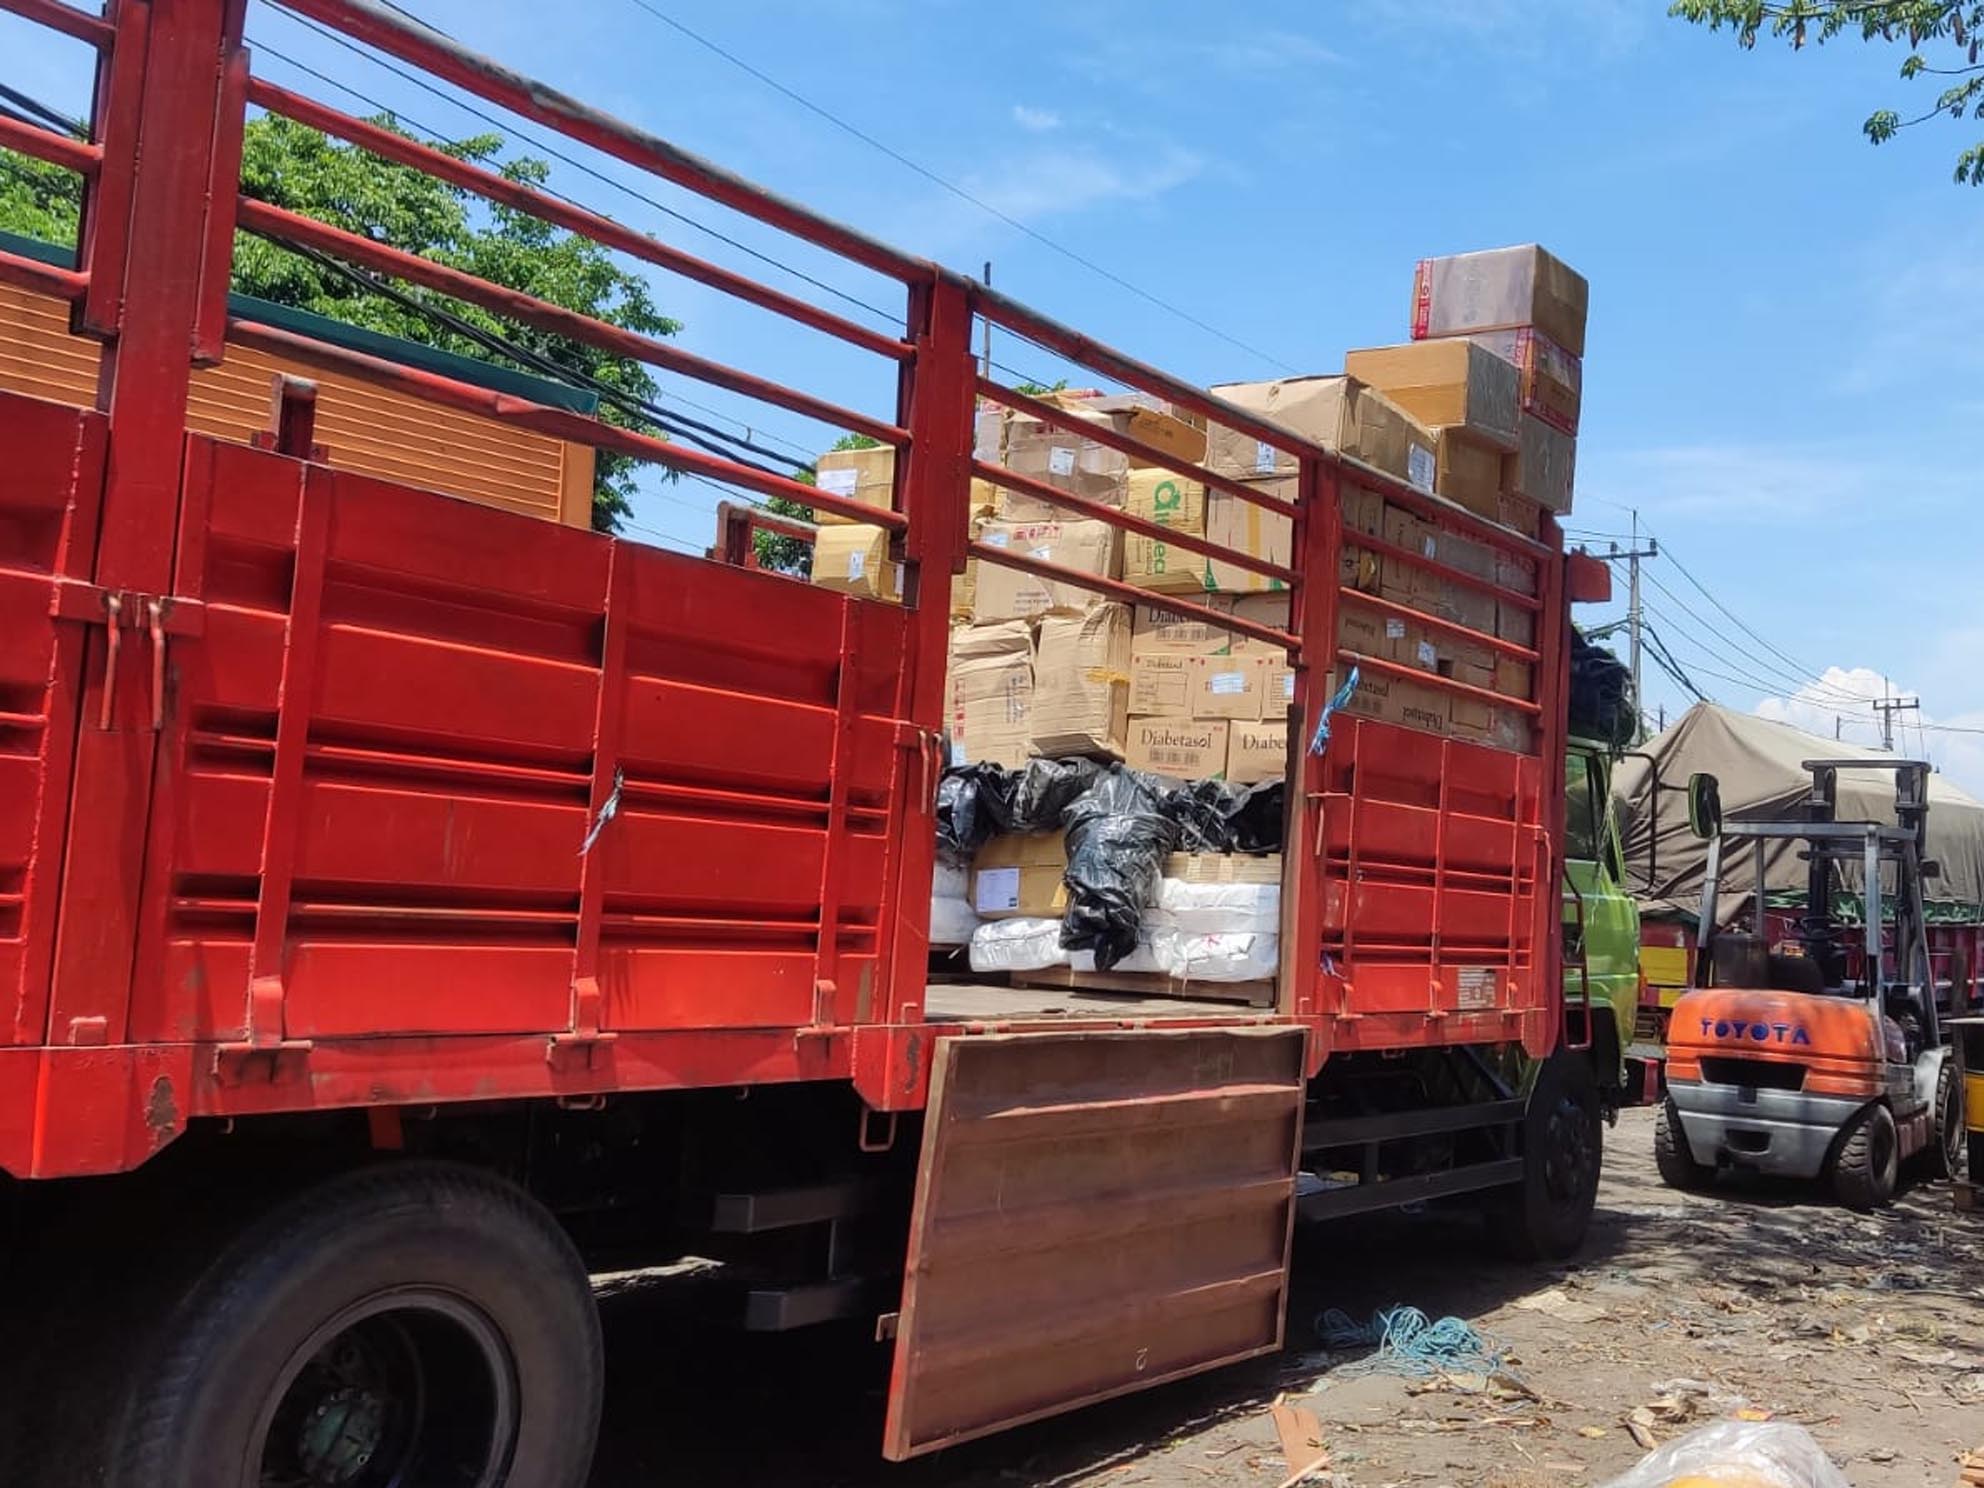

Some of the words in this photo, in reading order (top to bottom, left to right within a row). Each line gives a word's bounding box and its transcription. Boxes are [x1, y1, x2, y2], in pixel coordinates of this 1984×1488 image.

[1140, 728, 1212, 750] Diabetasol
[1243, 734, 1286, 750] Diabe
[1701, 1018, 1811, 1045] TOYOTA
